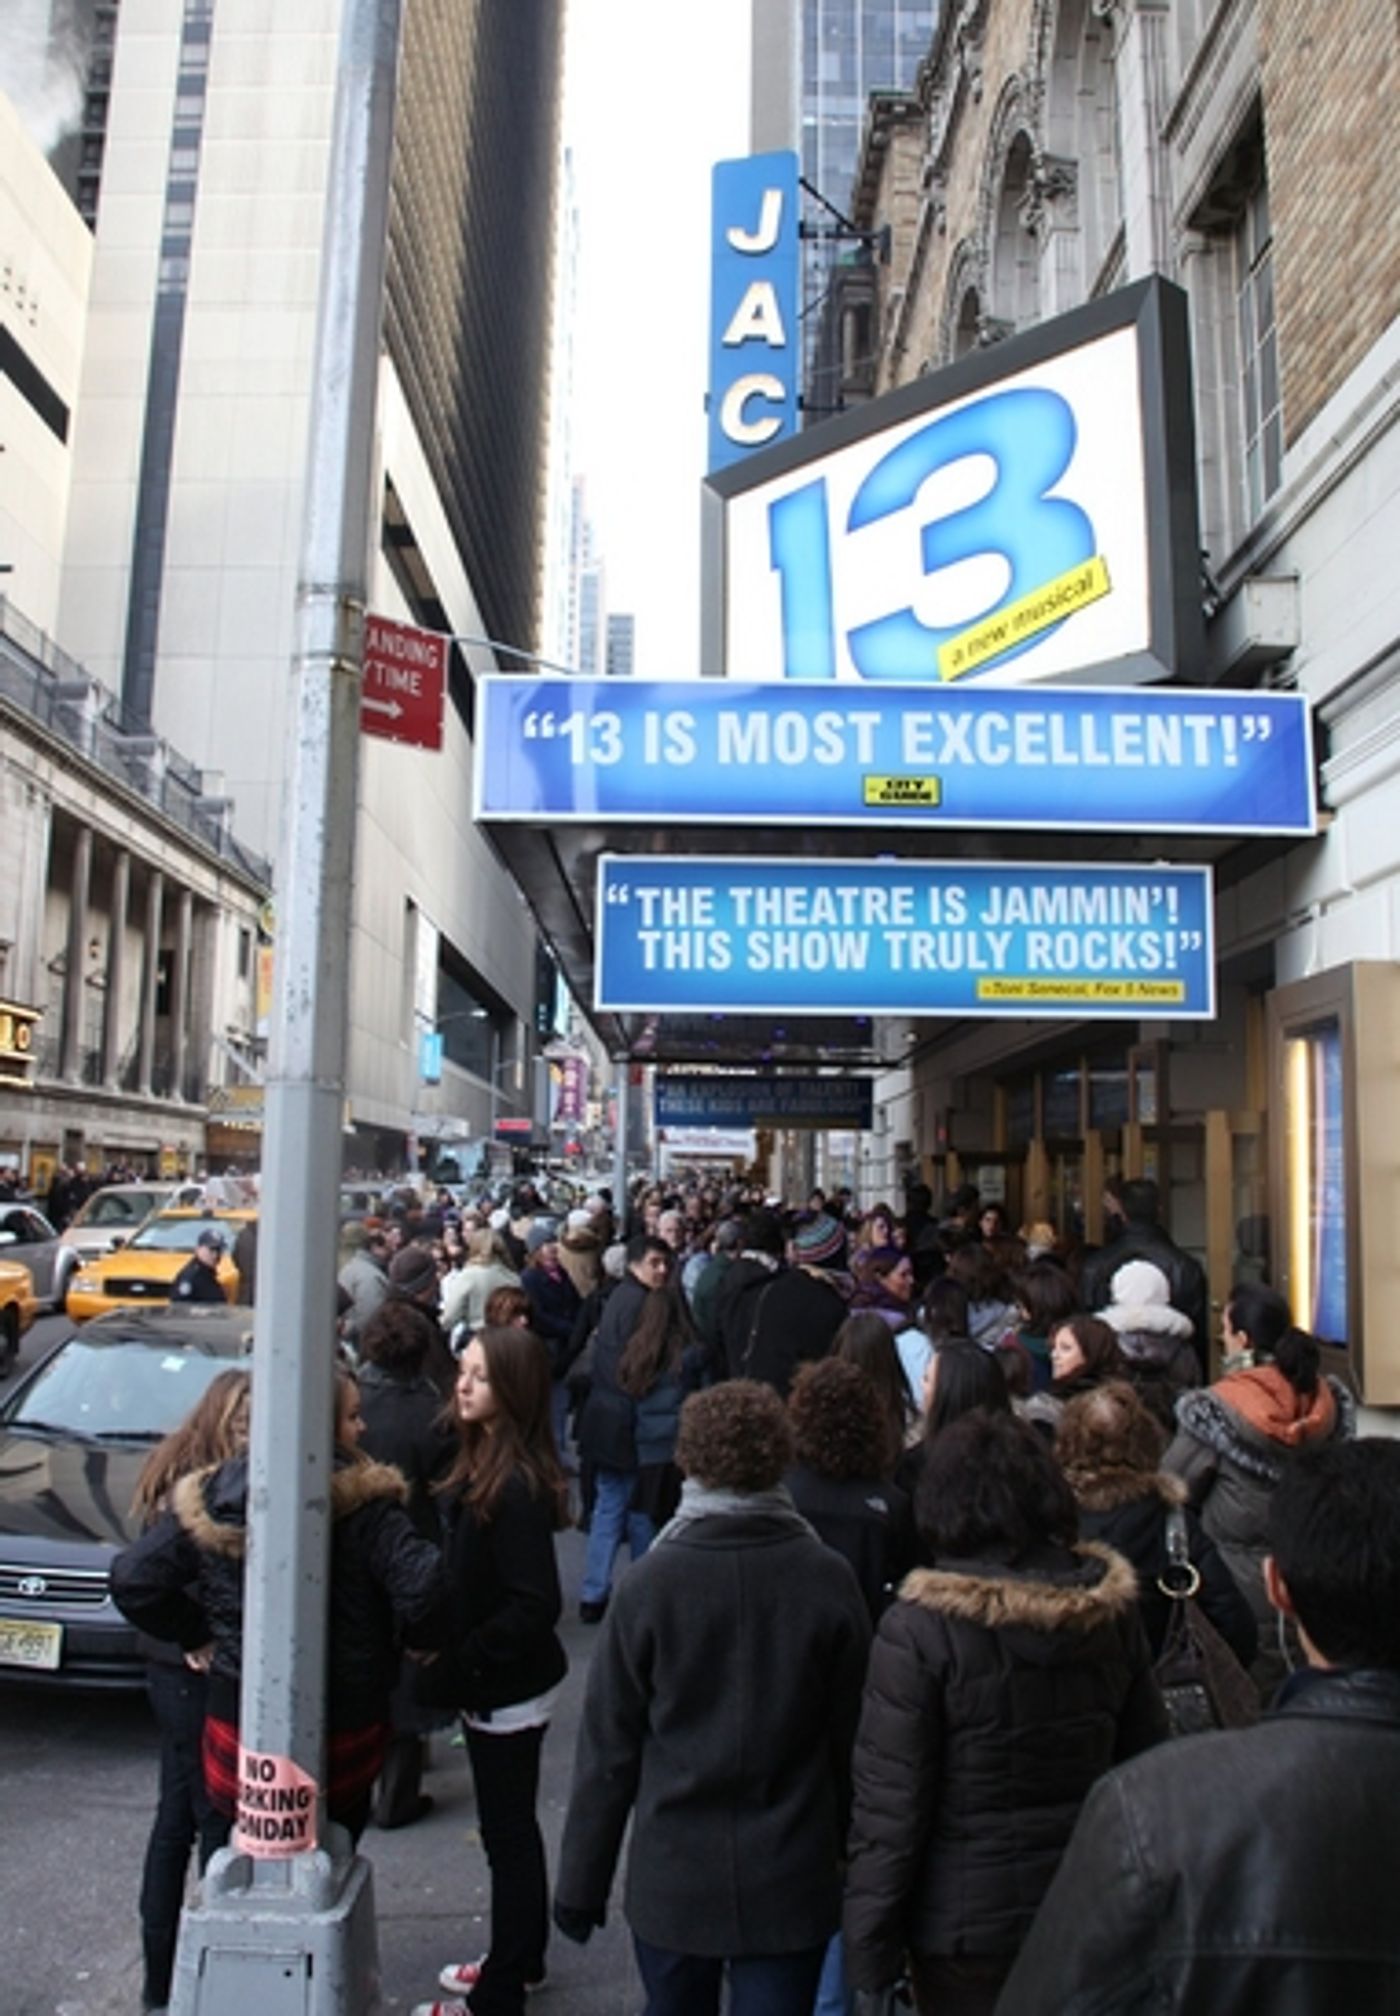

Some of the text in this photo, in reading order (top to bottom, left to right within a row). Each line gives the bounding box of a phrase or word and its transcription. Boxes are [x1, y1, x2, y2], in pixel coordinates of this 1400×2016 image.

[721, 188, 787, 447] JAC
[768, 385, 1097, 681] 13
[967, 622, 1009, 657] new
[1012, 568, 1094, 631] musical
[643, 710, 698, 766] IS
[717, 710, 882, 766] MOST
[729, 886, 914, 926] THEATRE
[930, 886, 967, 925] IS
[637, 930, 732, 970] THIS
[747, 930, 869, 970] SHOW
[883, 930, 1012, 970] TRULY
[246, 1756, 276, 1783] NO
